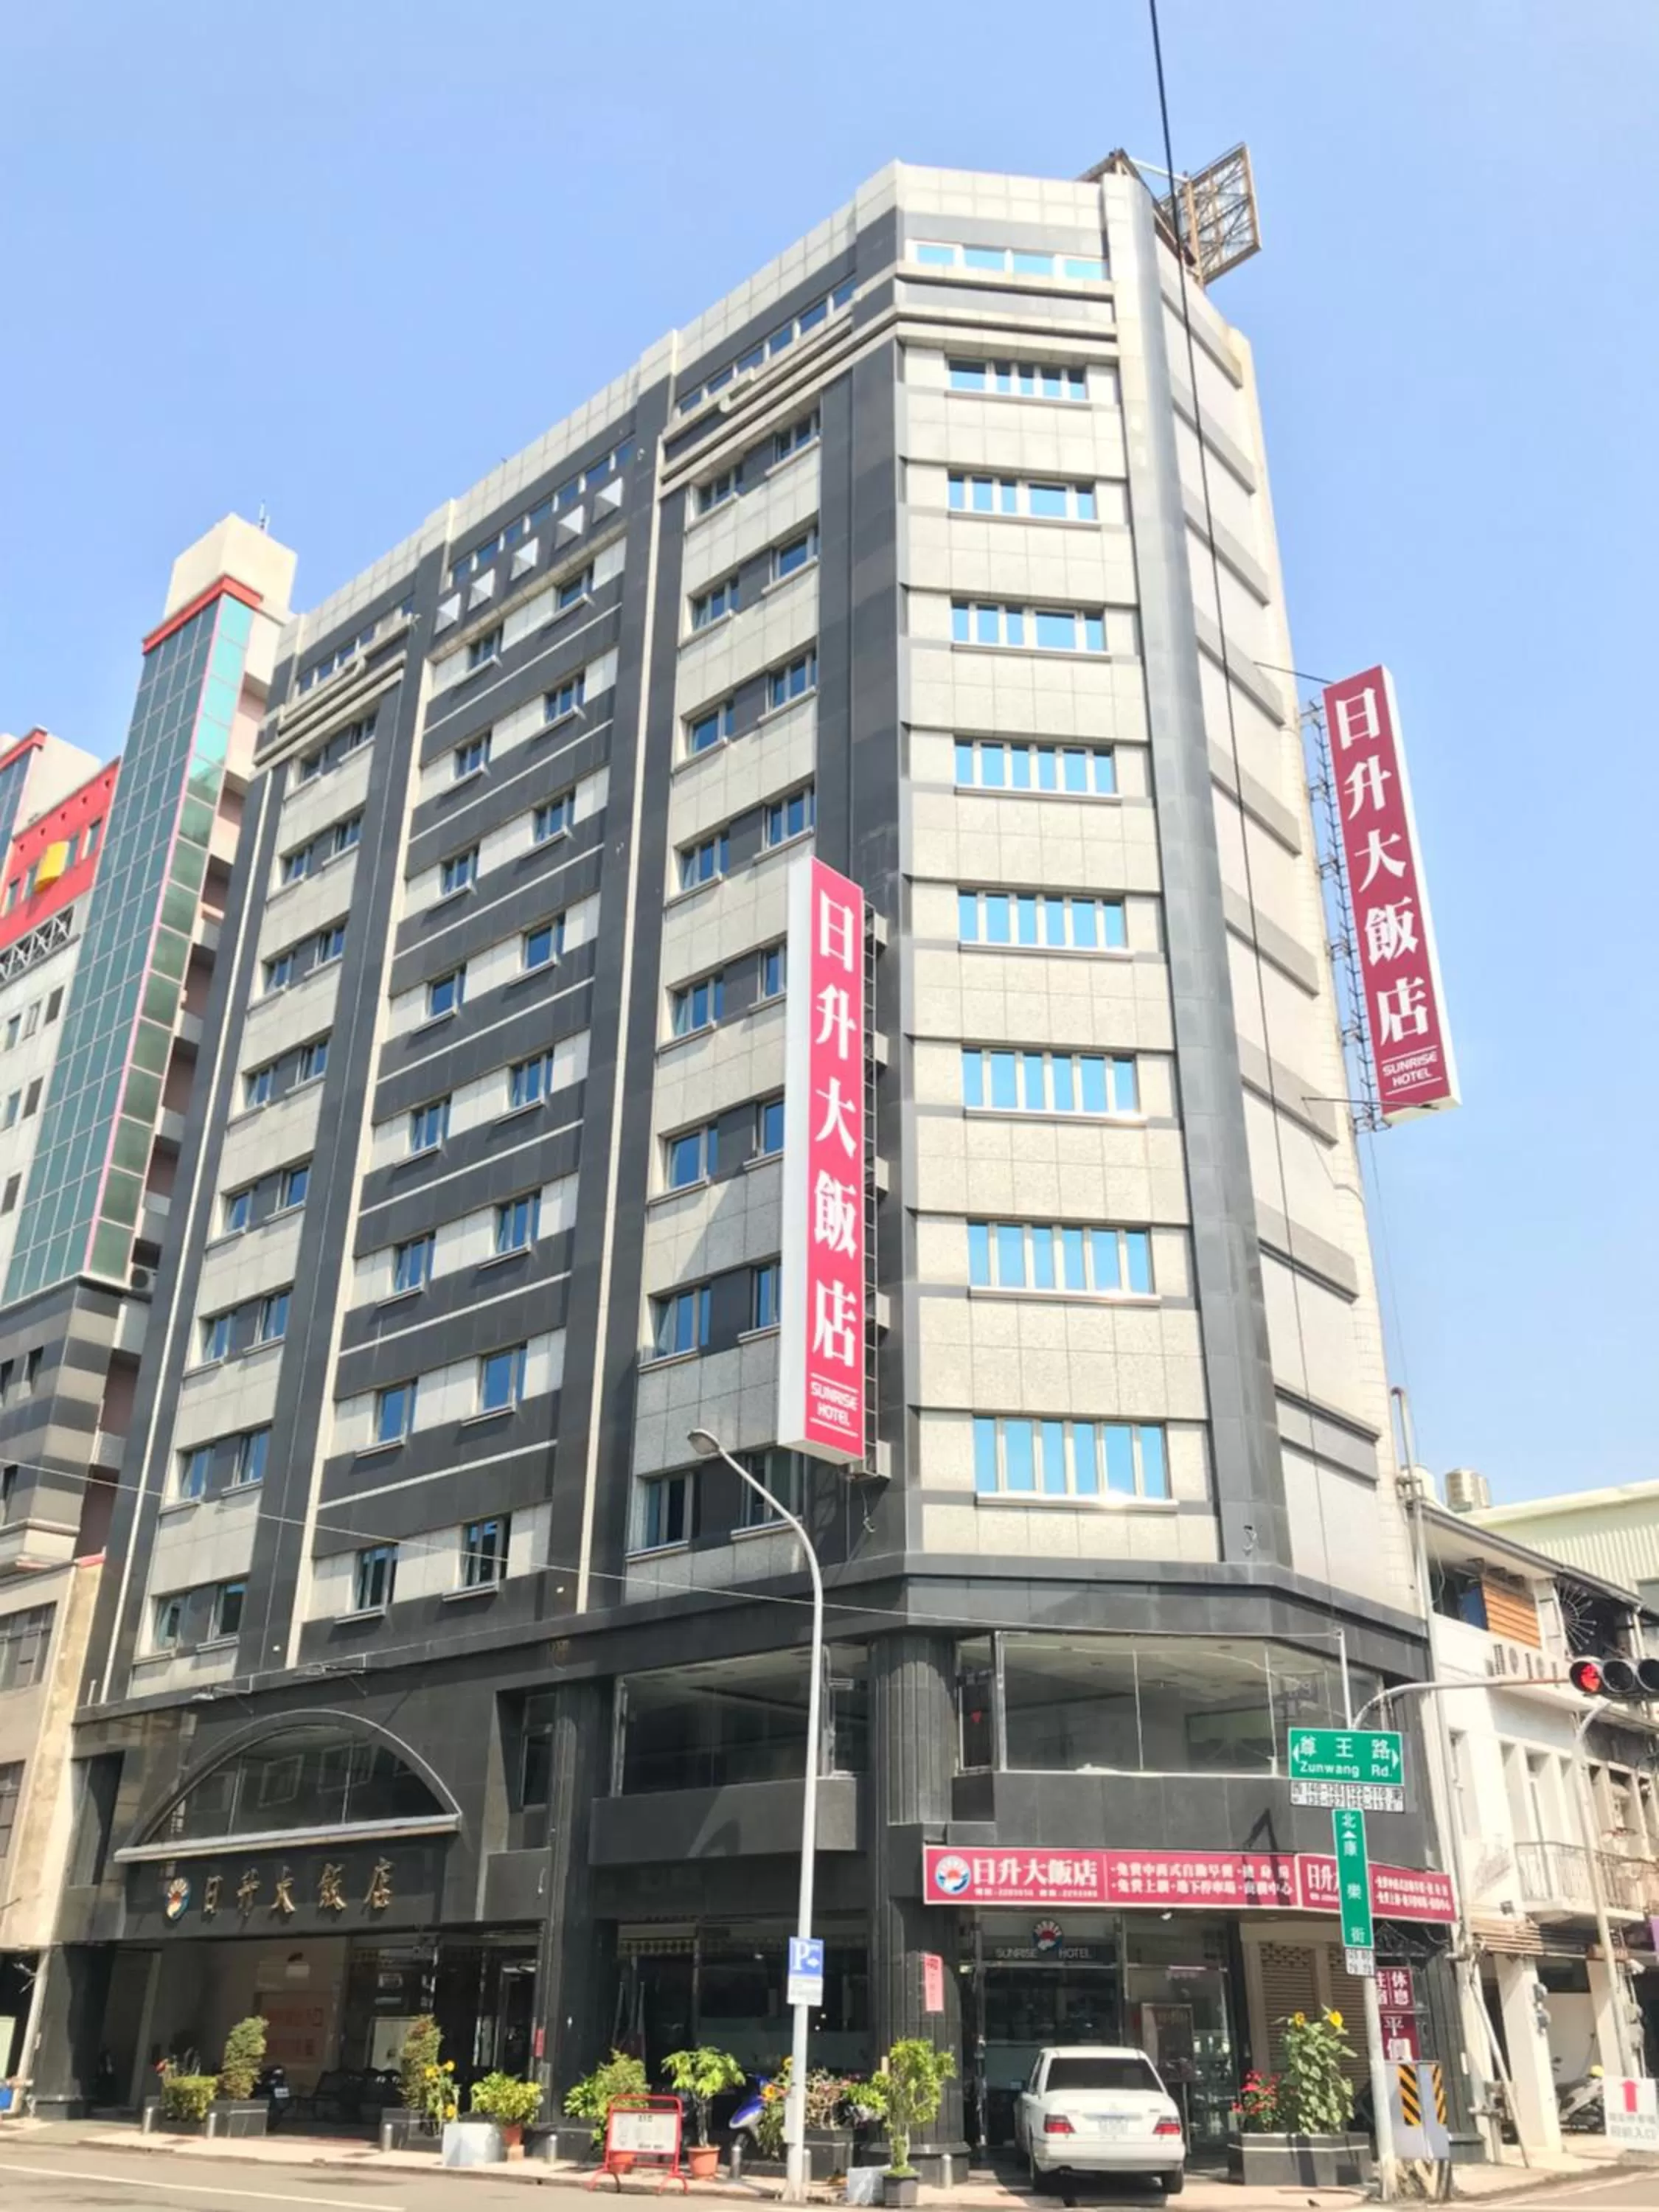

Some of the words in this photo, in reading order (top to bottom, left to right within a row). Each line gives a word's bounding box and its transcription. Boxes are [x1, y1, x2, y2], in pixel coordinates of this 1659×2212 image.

[1335, 686, 1430, 1046] 日升大飯店
[1382, 1051, 1437, 1077] SUNRISE
[1392, 1067, 1433, 1086] HOTEL
[813, 888, 857, 1367] 日升大飯店
[810, 1381, 858, 1412] SUNRISE
[817, 1402, 851, 1426] HOTEL
[1300, 1760, 1360, 1778] Zunwang
[1371, 1764, 1392, 1777] Rd.
[1341, 1813, 1356, 1829] 北
[973, 1857, 1098, 1887] 日升大飯店
[204, 1857, 392, 1916] 日升大飯店
[793, 1942, 809, 1971] P
[996, 1947, 1037, 1959] SUNRISE
[1059, 1948, 1093, 1959] HOTEL
